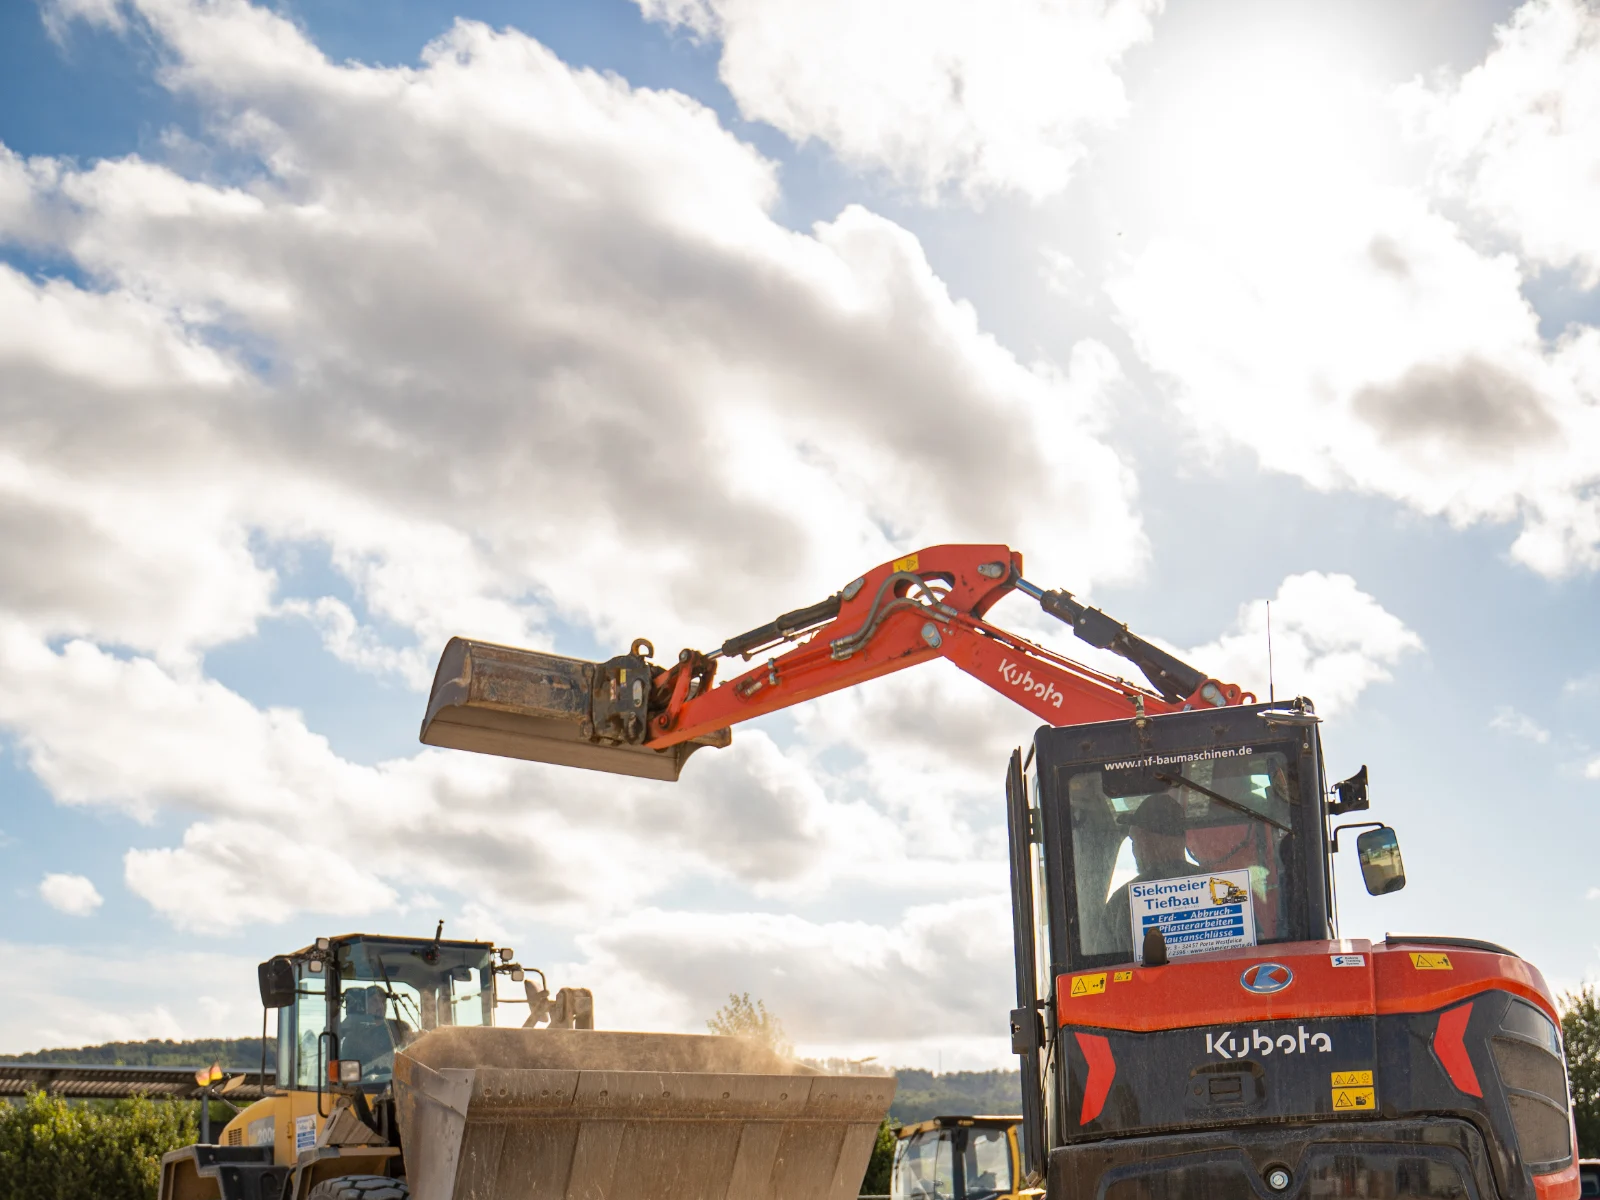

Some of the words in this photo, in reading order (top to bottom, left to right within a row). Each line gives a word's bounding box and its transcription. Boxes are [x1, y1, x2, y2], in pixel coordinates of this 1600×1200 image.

[998, 658, 1064, 709] Kubota
[1133, 880, 1207, 898] Siekmeier
[1144, 895, 1199, 910] Tiefbau
[1158, 914, 1177, 923] Erd-
[1190, 906, 1233, 920] Abbruch-
[1159, 918, 1233, 933] Pflasterarbeiten
[1206, 1025, 1332, 1059] Kubota
